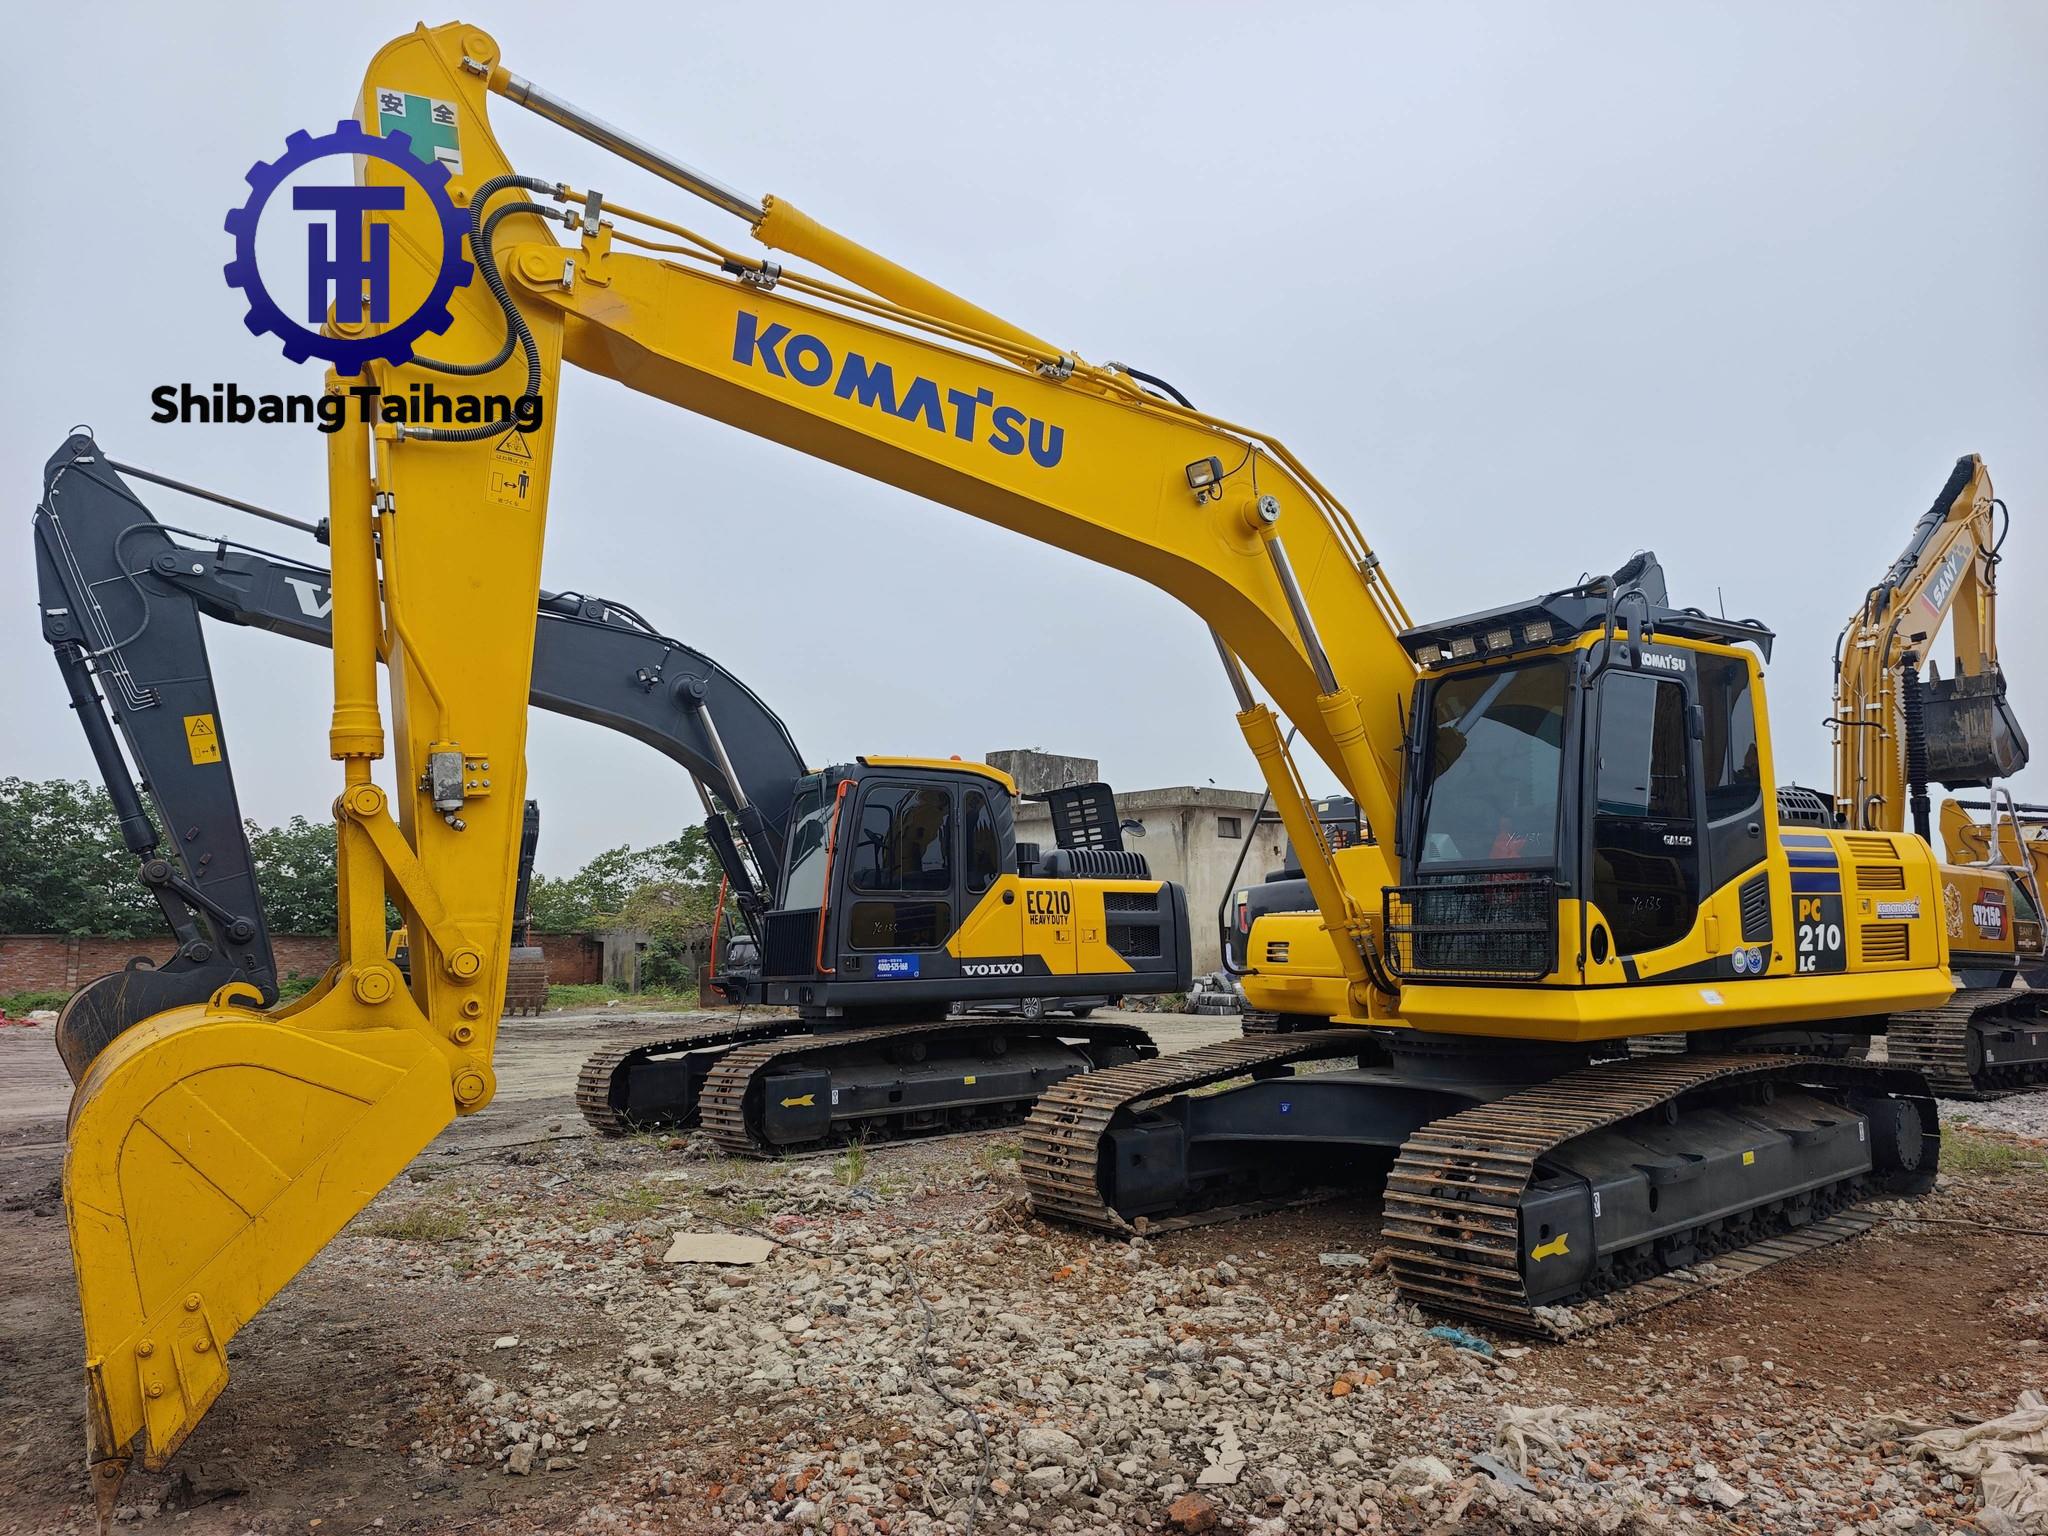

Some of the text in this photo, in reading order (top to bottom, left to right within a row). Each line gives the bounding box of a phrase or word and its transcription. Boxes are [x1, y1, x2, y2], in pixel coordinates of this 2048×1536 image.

[732, 311, 1064, 468] KOMATSU
[1933, 554, 1958, 608] SANY
[1026, 890, 1070, 914] EC210
[1799, 898, 1821, 921] PC
[1030, 915, 1069, 925] HEAVY DUTY
[1973, 904, 2001, 926] SY215C
[1799, 924, 1841, 951] 210
[962, 963, 1023, 976] VOLVO
[1799, 955, 1816, 972] LC
